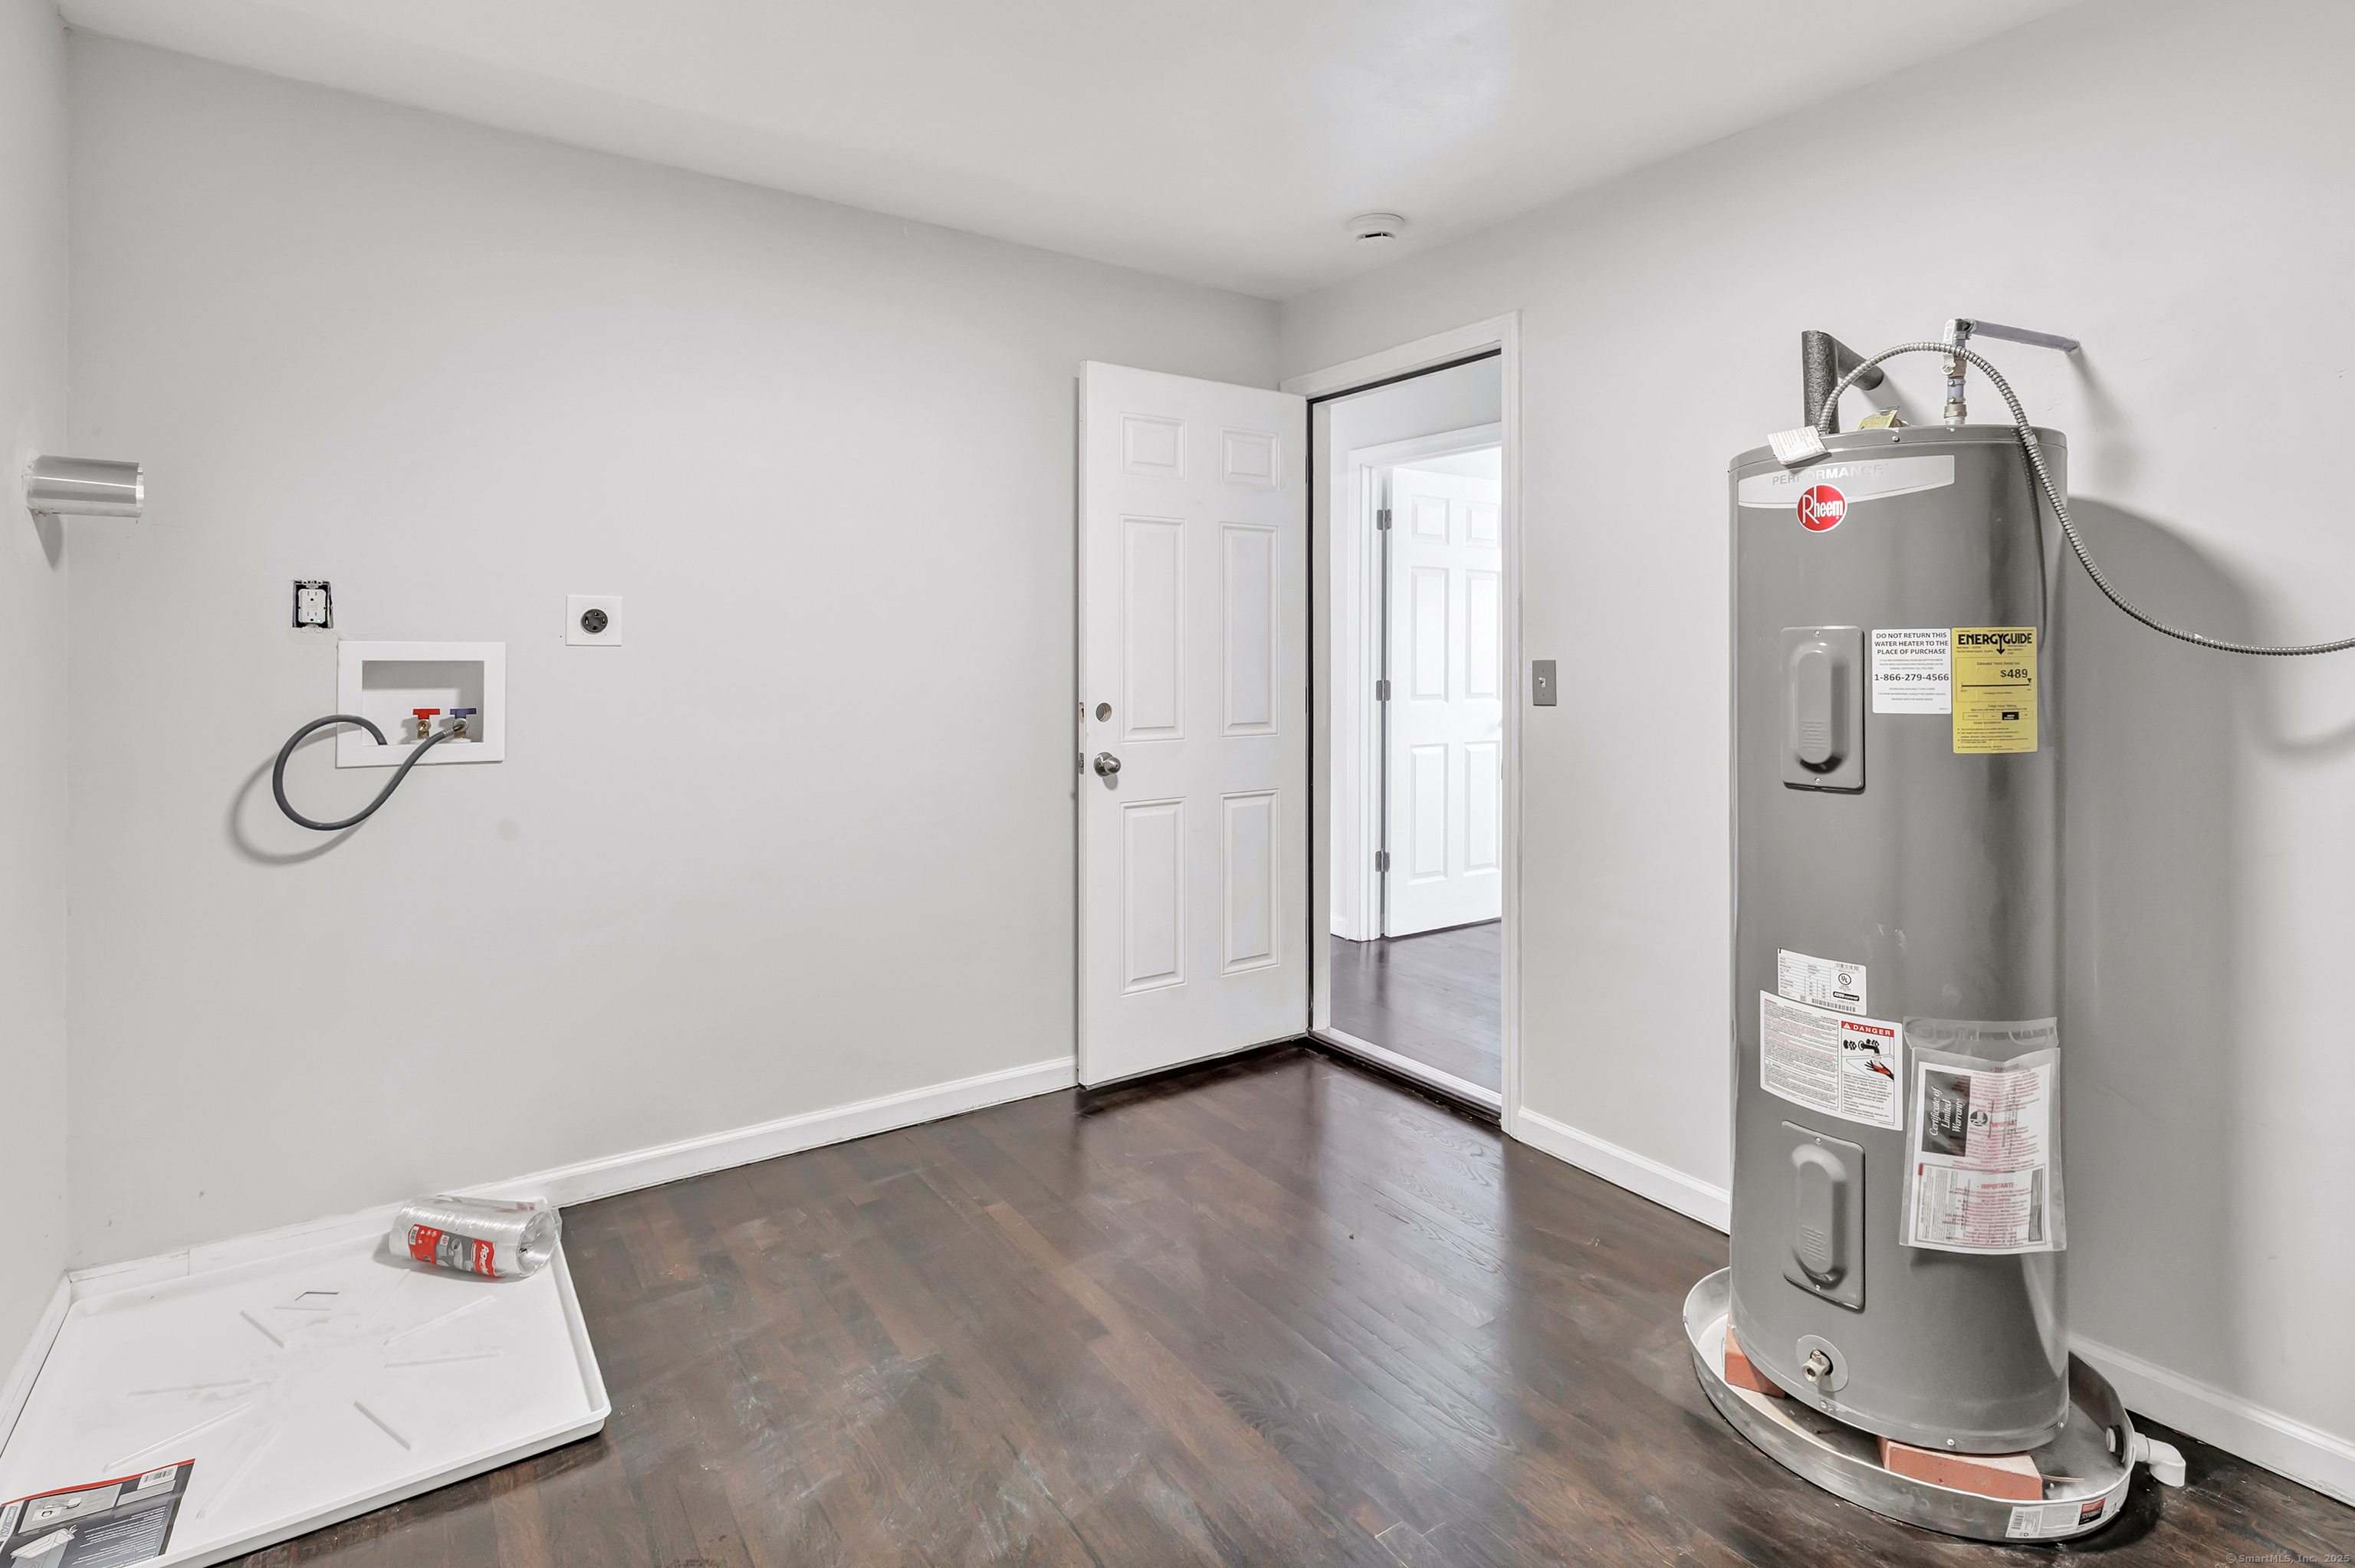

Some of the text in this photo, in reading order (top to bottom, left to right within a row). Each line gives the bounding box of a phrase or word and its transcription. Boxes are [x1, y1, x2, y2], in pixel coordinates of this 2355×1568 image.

[1772, 464, 1884, 485] PERFORMANCE
[1802, 485, 1843, 524] Rheem
[1958, 633, 2032, 645] ENERGYGUIDE
[2000, 668, 2028, 678] $489
[1853, 1024, 1890, 1036] DANGER
[1930, 1085, 1942, 1136] Certificate of
[1941, 1098, 1951, 1129] Limited
[1952, 1098, 1965, 1133] Warranty
